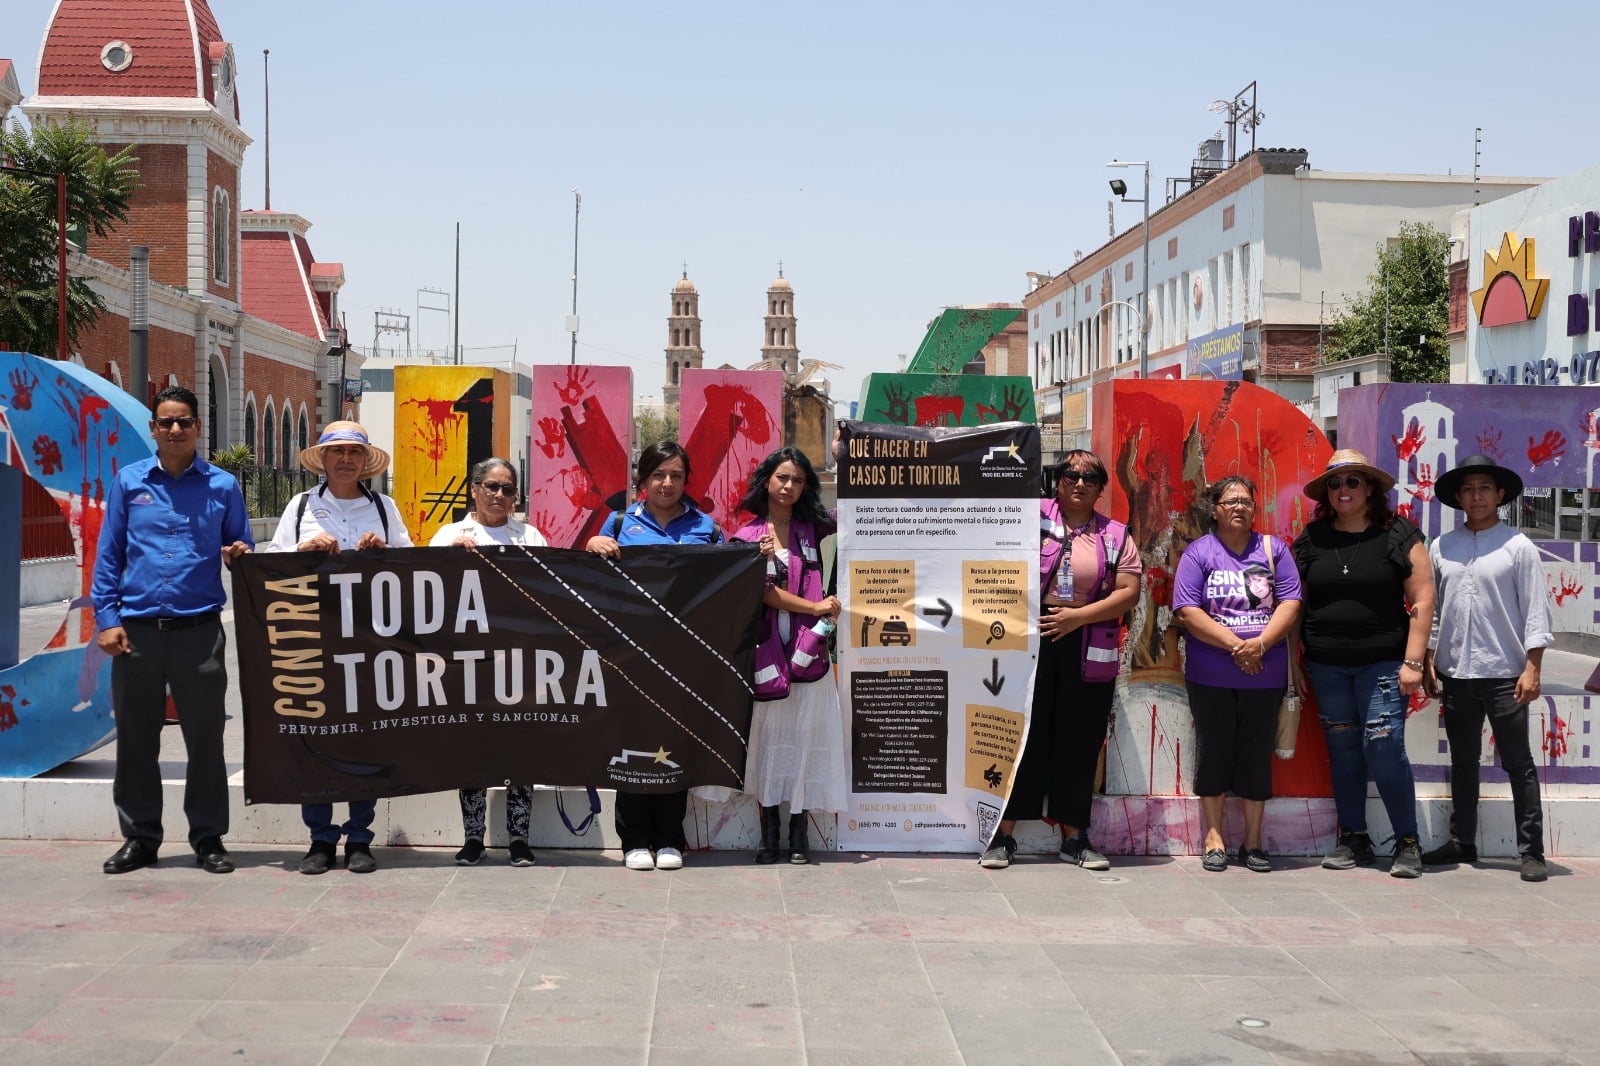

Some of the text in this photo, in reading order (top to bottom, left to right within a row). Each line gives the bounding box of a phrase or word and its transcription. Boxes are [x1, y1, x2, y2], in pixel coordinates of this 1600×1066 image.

[850, 435, 928, 459] QUÉ HACER EN
[850, 465, 960, 485] CASOS DE TORTURA
[875, 517, 894, 526] inflige
[916, 528, 925, 536] fin
[998, 568, 1020, 576] persona
[1207, 586, 1246, 599] ELLAS
[329, 569, 490, 638] TODA
[264, 574, 326, 719] CONTRA
[333, 648, 608, 713] TORTURA
[279, 712, 581, 736] PREVENIR, INVESTIGAR Y SANCIONAR
[610, 773, 627, 782] PASO
[628, 776, 640, 784] DEL
